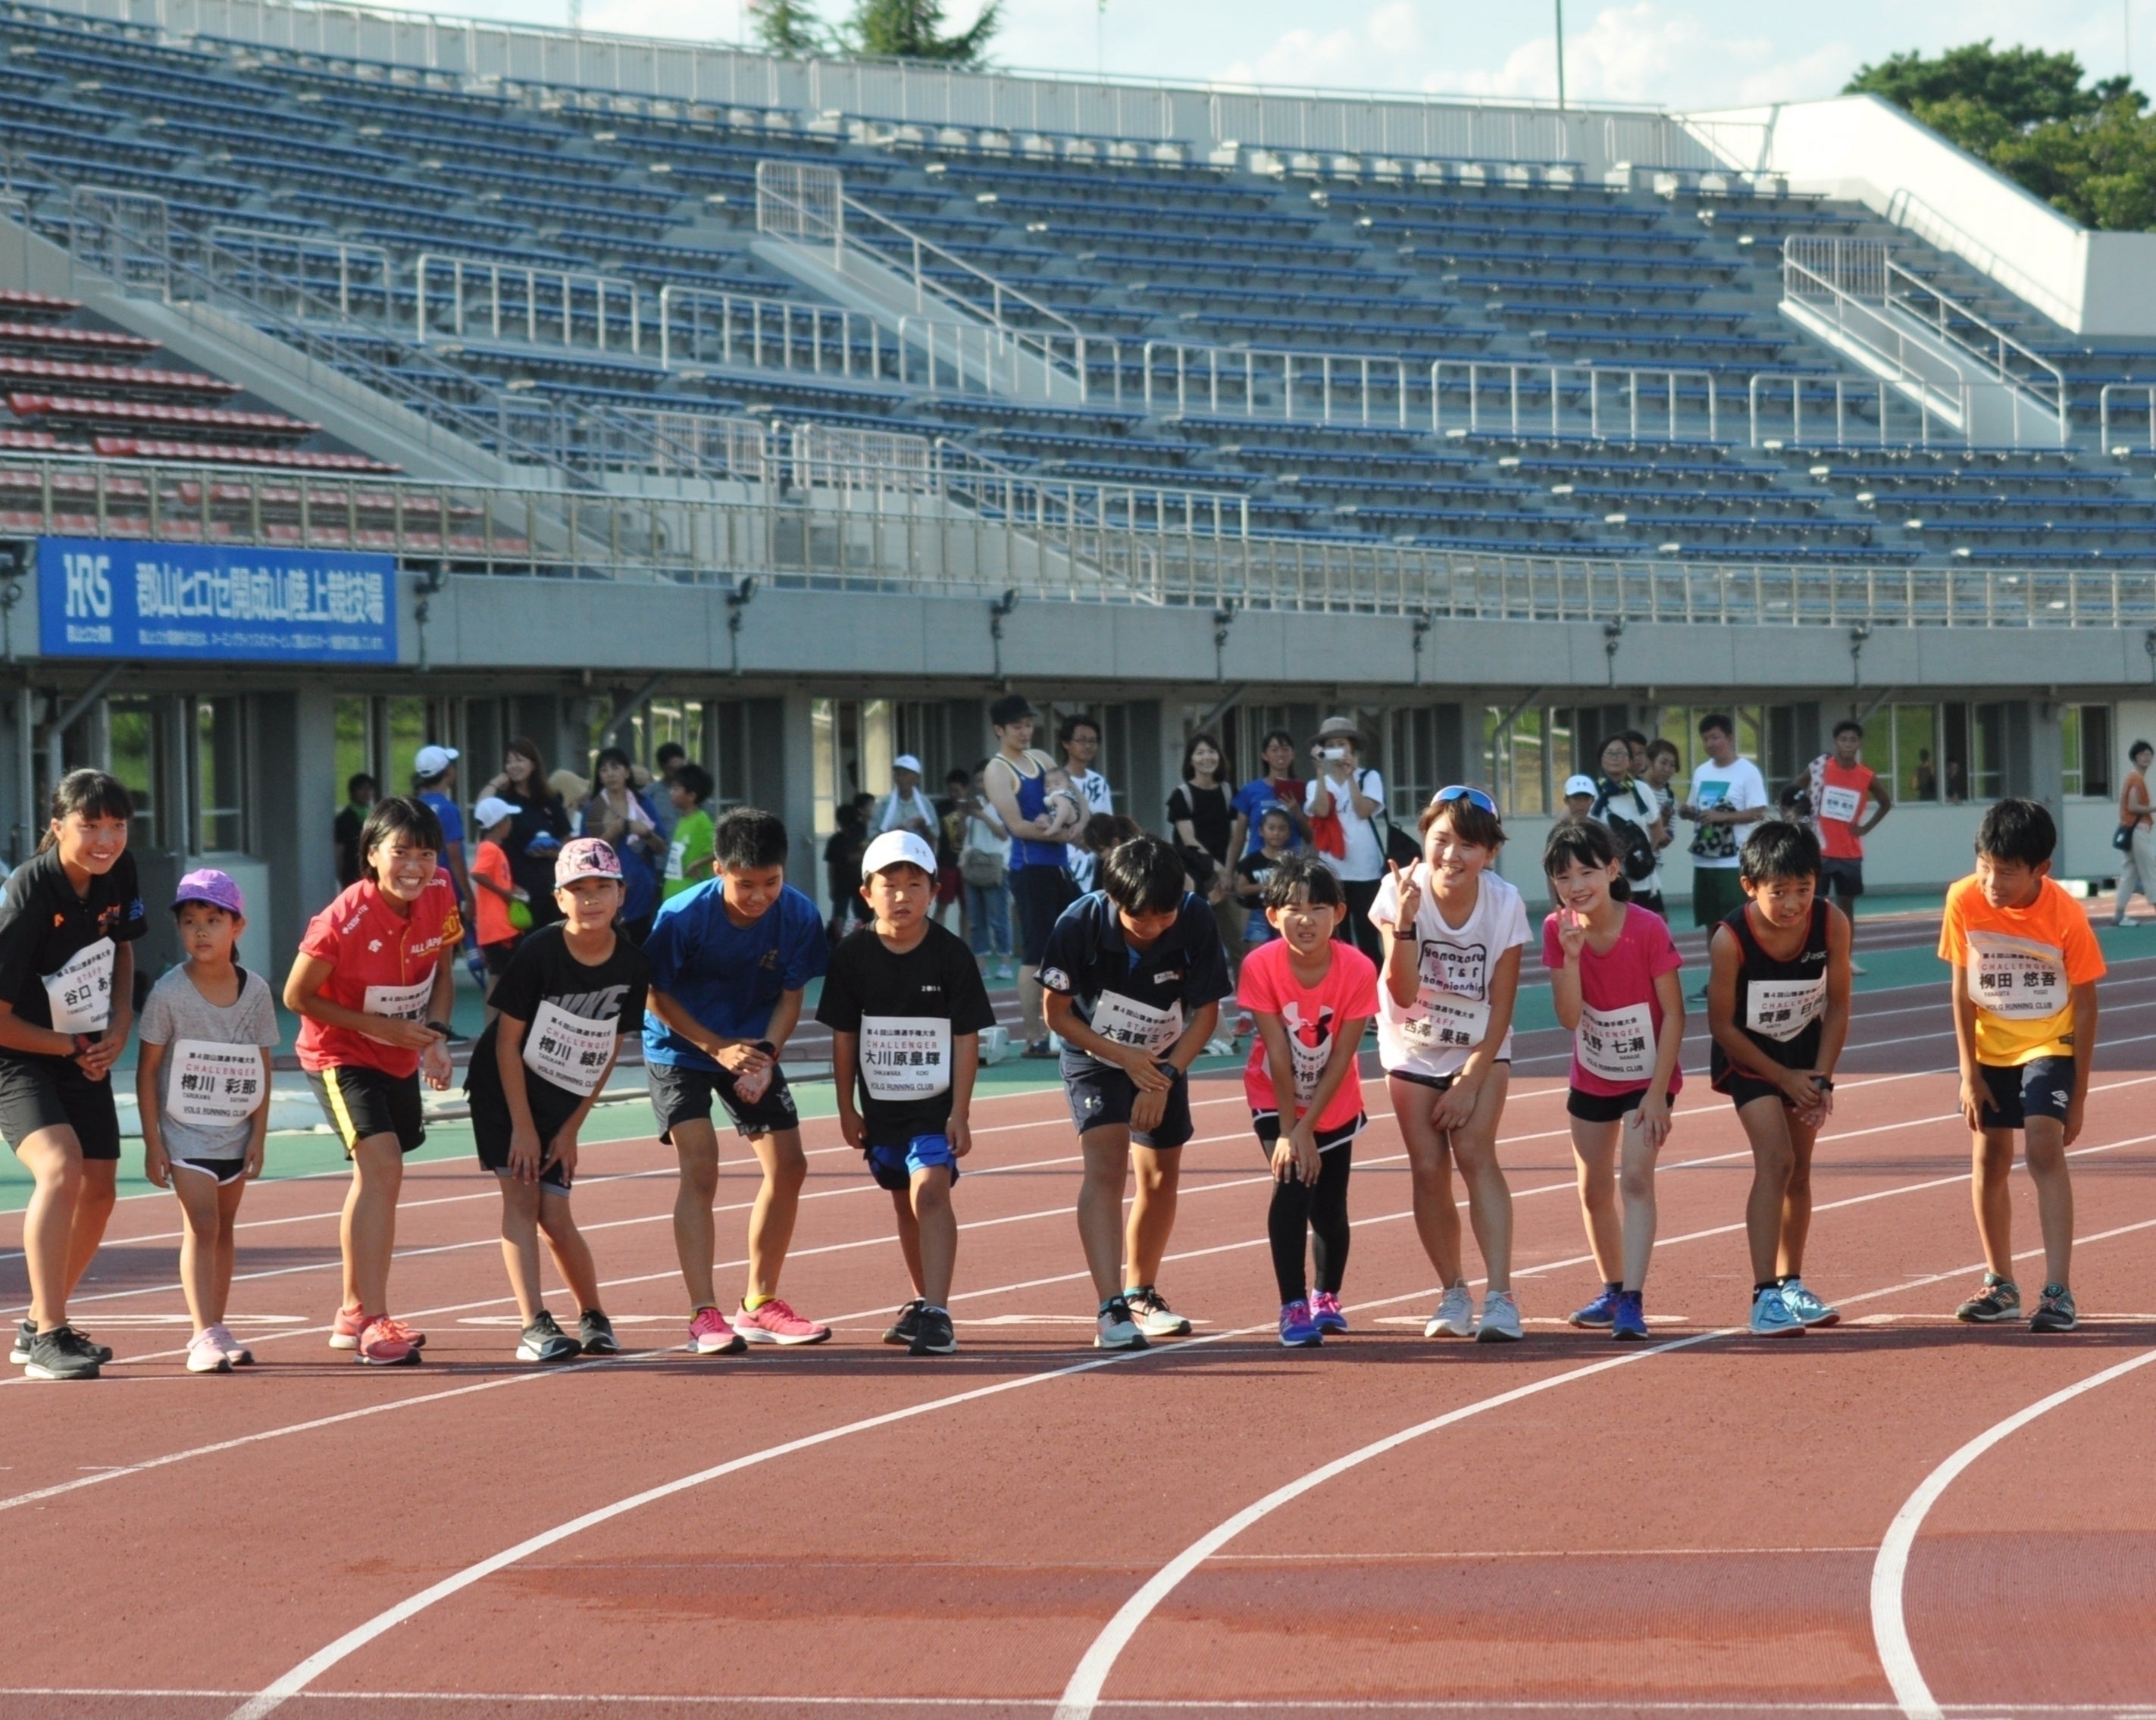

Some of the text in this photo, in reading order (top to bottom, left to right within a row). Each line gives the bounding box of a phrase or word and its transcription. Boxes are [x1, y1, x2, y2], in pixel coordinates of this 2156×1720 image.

[64, 553, 111, 618] HRS
[425, 937, 443, 950] JAPA
[1425, 947, 1485, 963] yamazaru
[1448, 967, 1454, 977] T
[1979, 971, 2057, 989] 柳田 悠吾
[64, 984, 92, 1006] 谷口
[2004, 1002, 2033, 1011] RUNNING
[2035, 1002, 2052, 1010] CLUB
[1440, 1027, 1471, 1045] 果穂
[866, 1040, 937, 1049] CHALLENGER
[1611, 1036, 1645, 1053] 七瀬
[865, 1049, 940, 1066] 大川原皇輝
[186, 1063, 256, 1077] CHALLENGER
[181, 1073, 257, 1095] 樽川 彩那
[555, 1071, 583, 1087] RUNNING
[887, 1083, 915, 1091] RUNNING
[183, 1105, 201, 1115] VOLG
[202, 1107, 230, 1117] RUNNING
